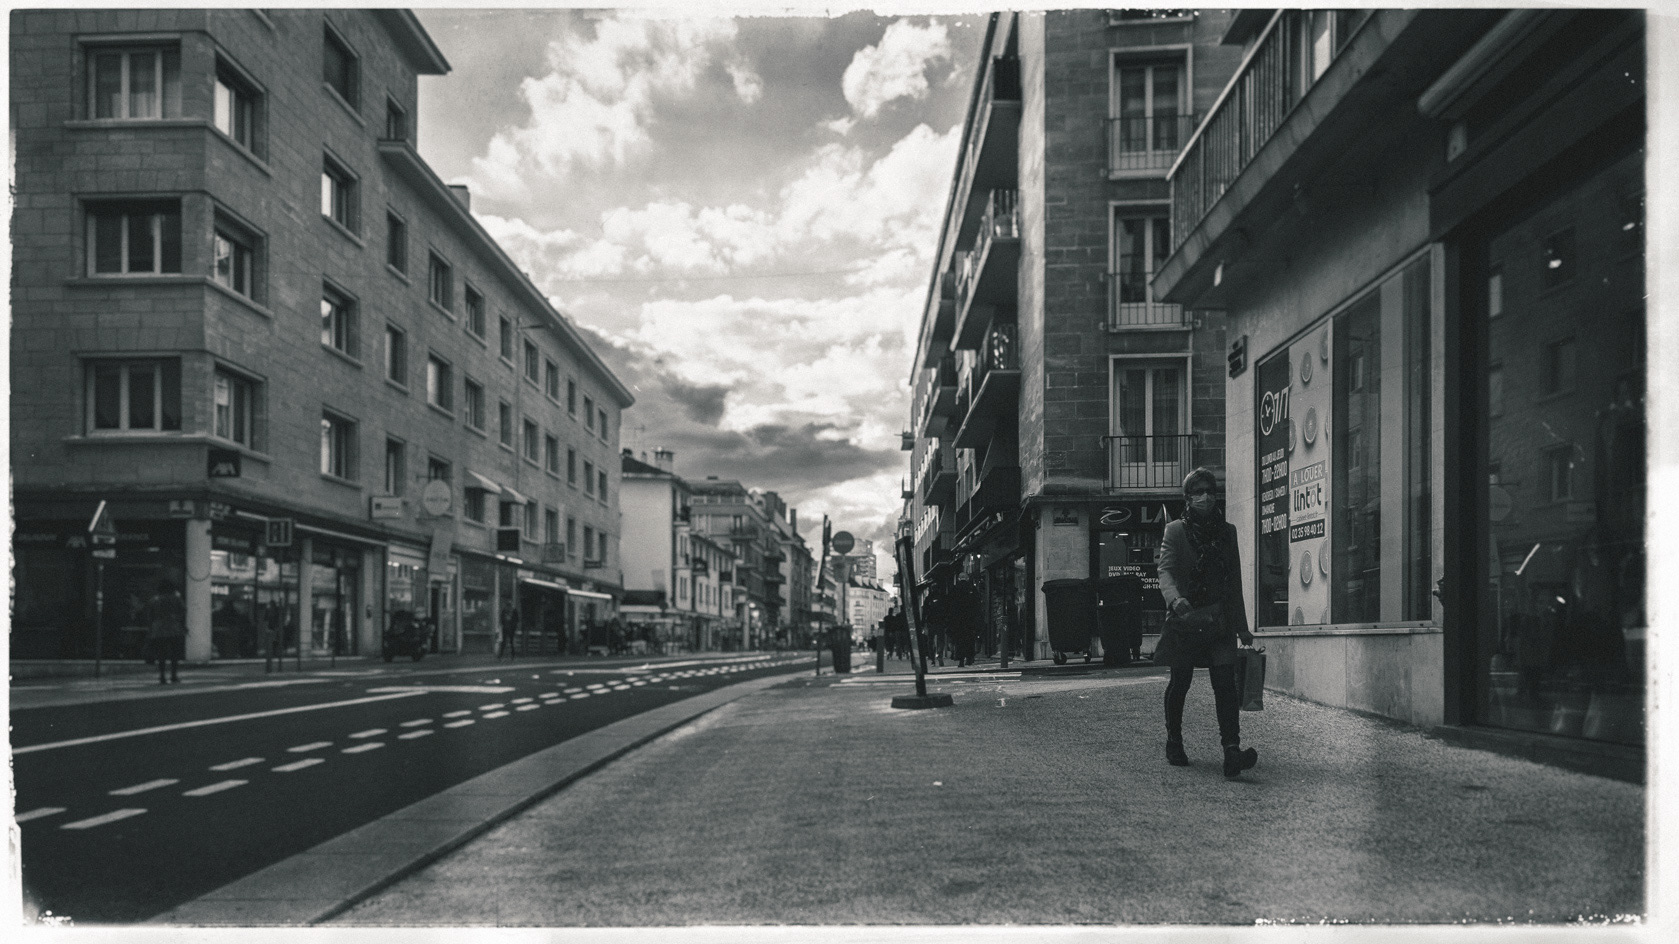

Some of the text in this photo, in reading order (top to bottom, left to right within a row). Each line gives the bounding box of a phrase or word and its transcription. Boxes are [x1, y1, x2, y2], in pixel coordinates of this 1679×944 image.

[1274, 386, 1289, 424] 7/7
[1300, 463, 1323, 483] LOUER
[1293, 483, 1322, 512] lintot
[1317, 522, 1323, 534] 12
